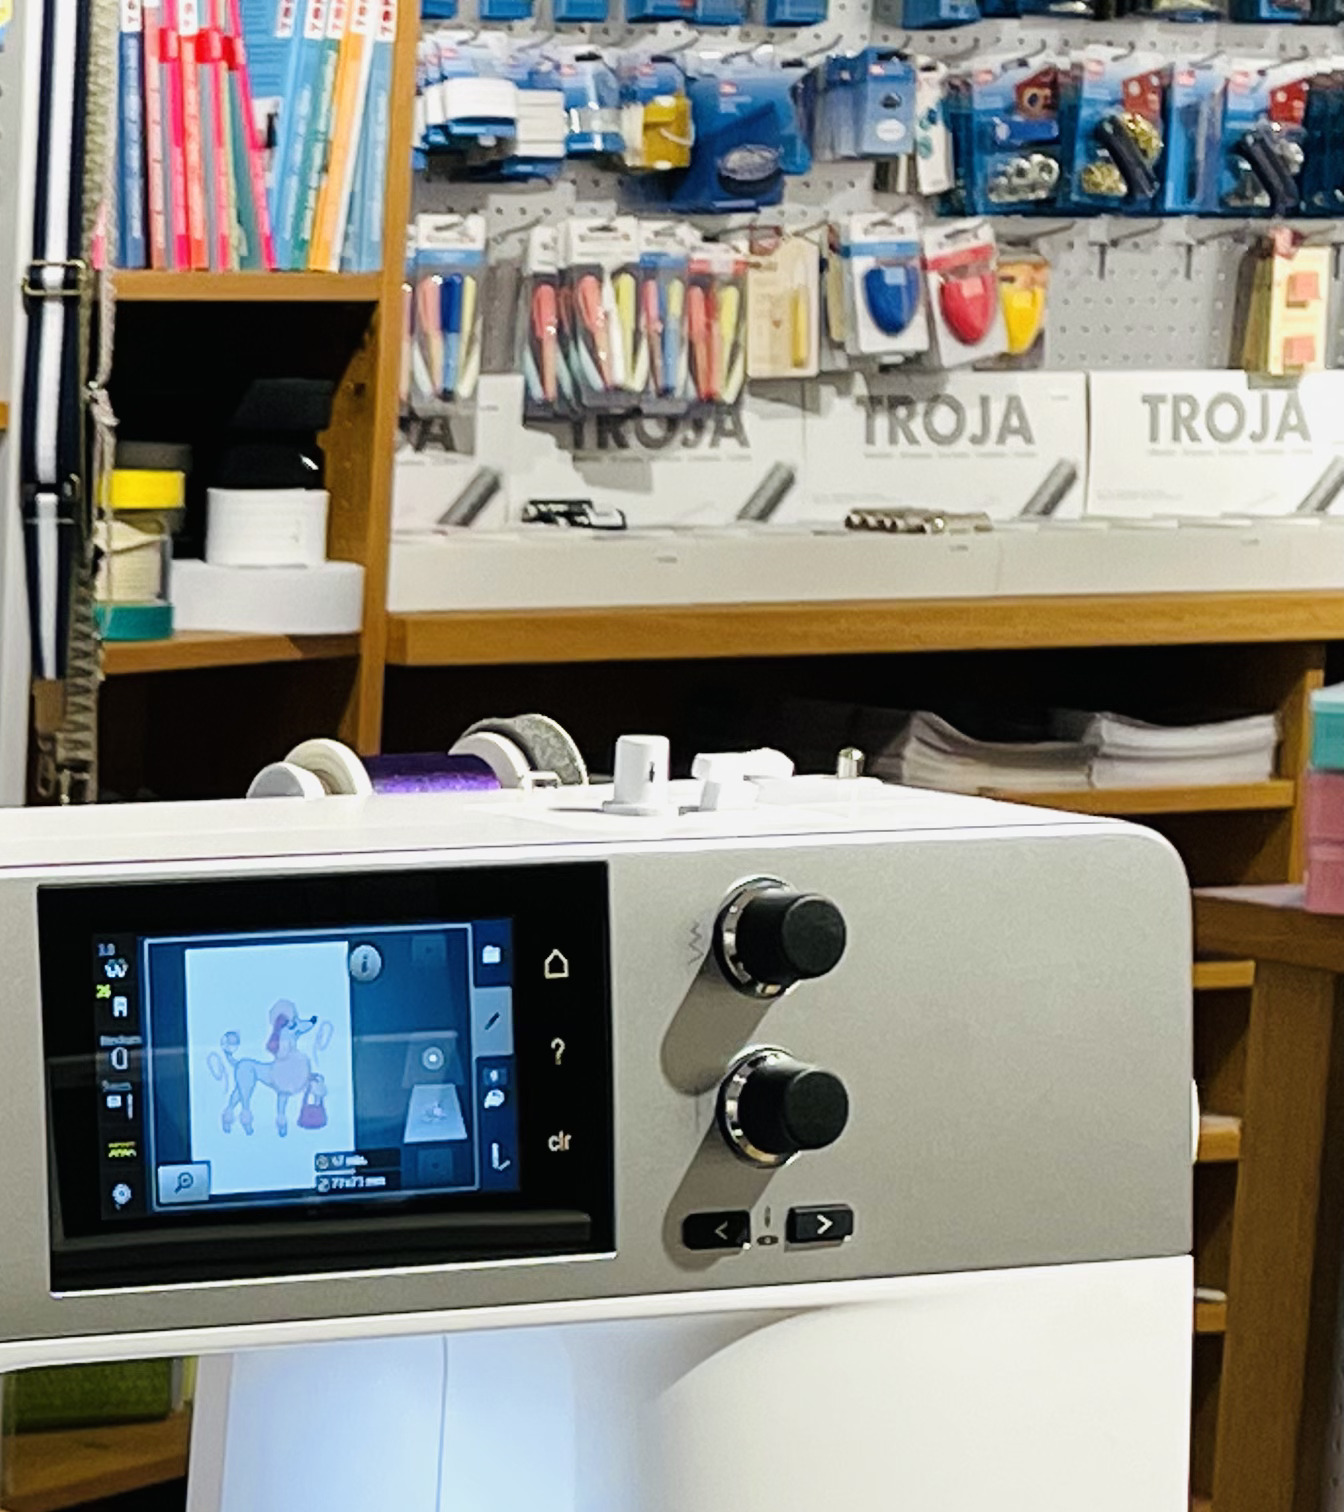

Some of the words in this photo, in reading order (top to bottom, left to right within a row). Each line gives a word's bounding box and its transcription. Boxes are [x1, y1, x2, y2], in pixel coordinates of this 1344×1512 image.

[855, 394, 1035, 446] TROJA
[1141, 392, 1312, 443] TROJA
[548, 1130, 572, 1152] clr
